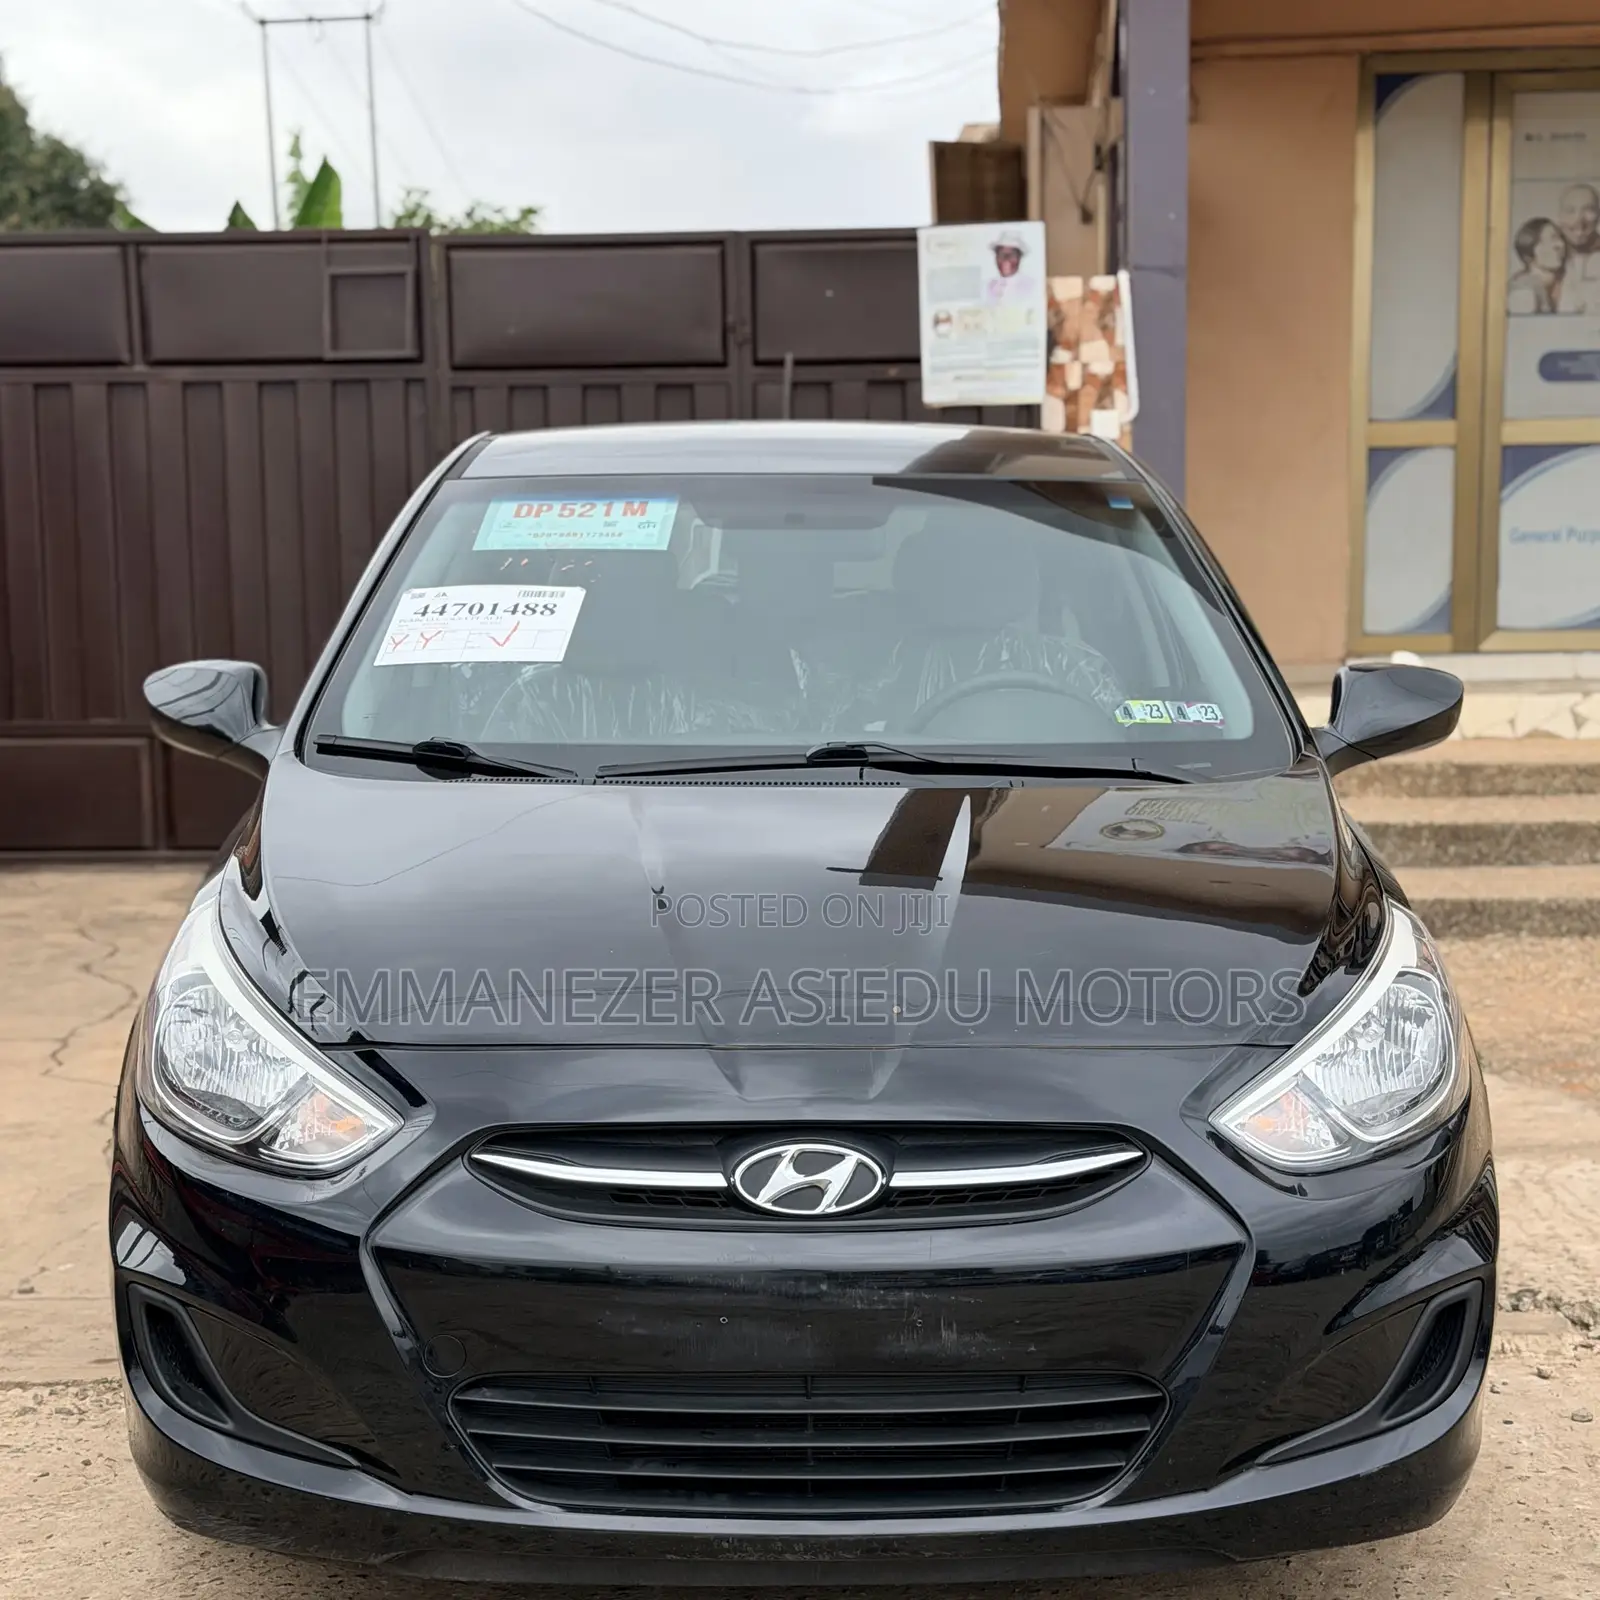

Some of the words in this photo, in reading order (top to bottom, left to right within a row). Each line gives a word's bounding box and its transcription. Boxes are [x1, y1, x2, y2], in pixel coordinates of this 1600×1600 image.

[512, 502, 554, 519] DP
[557, 501, 615, 519] 521
[621, 500, 650, 518] M
[413, 601, 559, 618] 44701488
